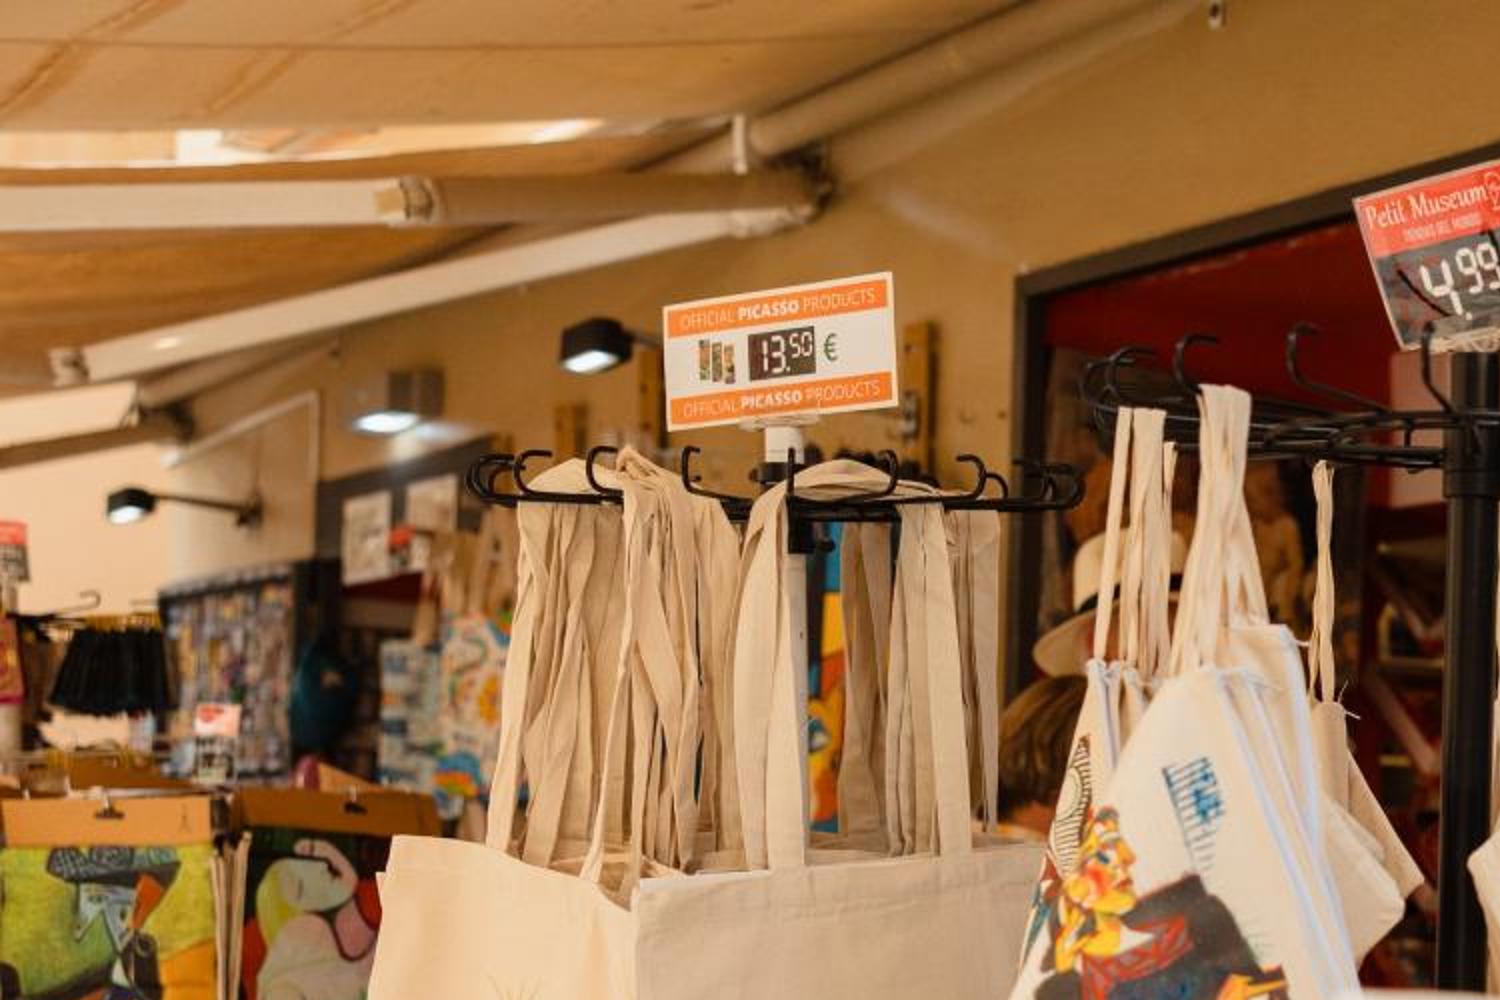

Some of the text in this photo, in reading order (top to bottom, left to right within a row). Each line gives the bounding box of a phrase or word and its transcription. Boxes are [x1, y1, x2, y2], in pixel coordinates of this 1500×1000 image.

[1365, 200, 1405, 230] Petit
[1407, 184, 1488, 220] Museum
[680, 288, 876, 329] OFFICIAL PICASSO PRODUCTS
[823, 332, 840, 363] €
[741, 389, 803, 410] PICASSO
